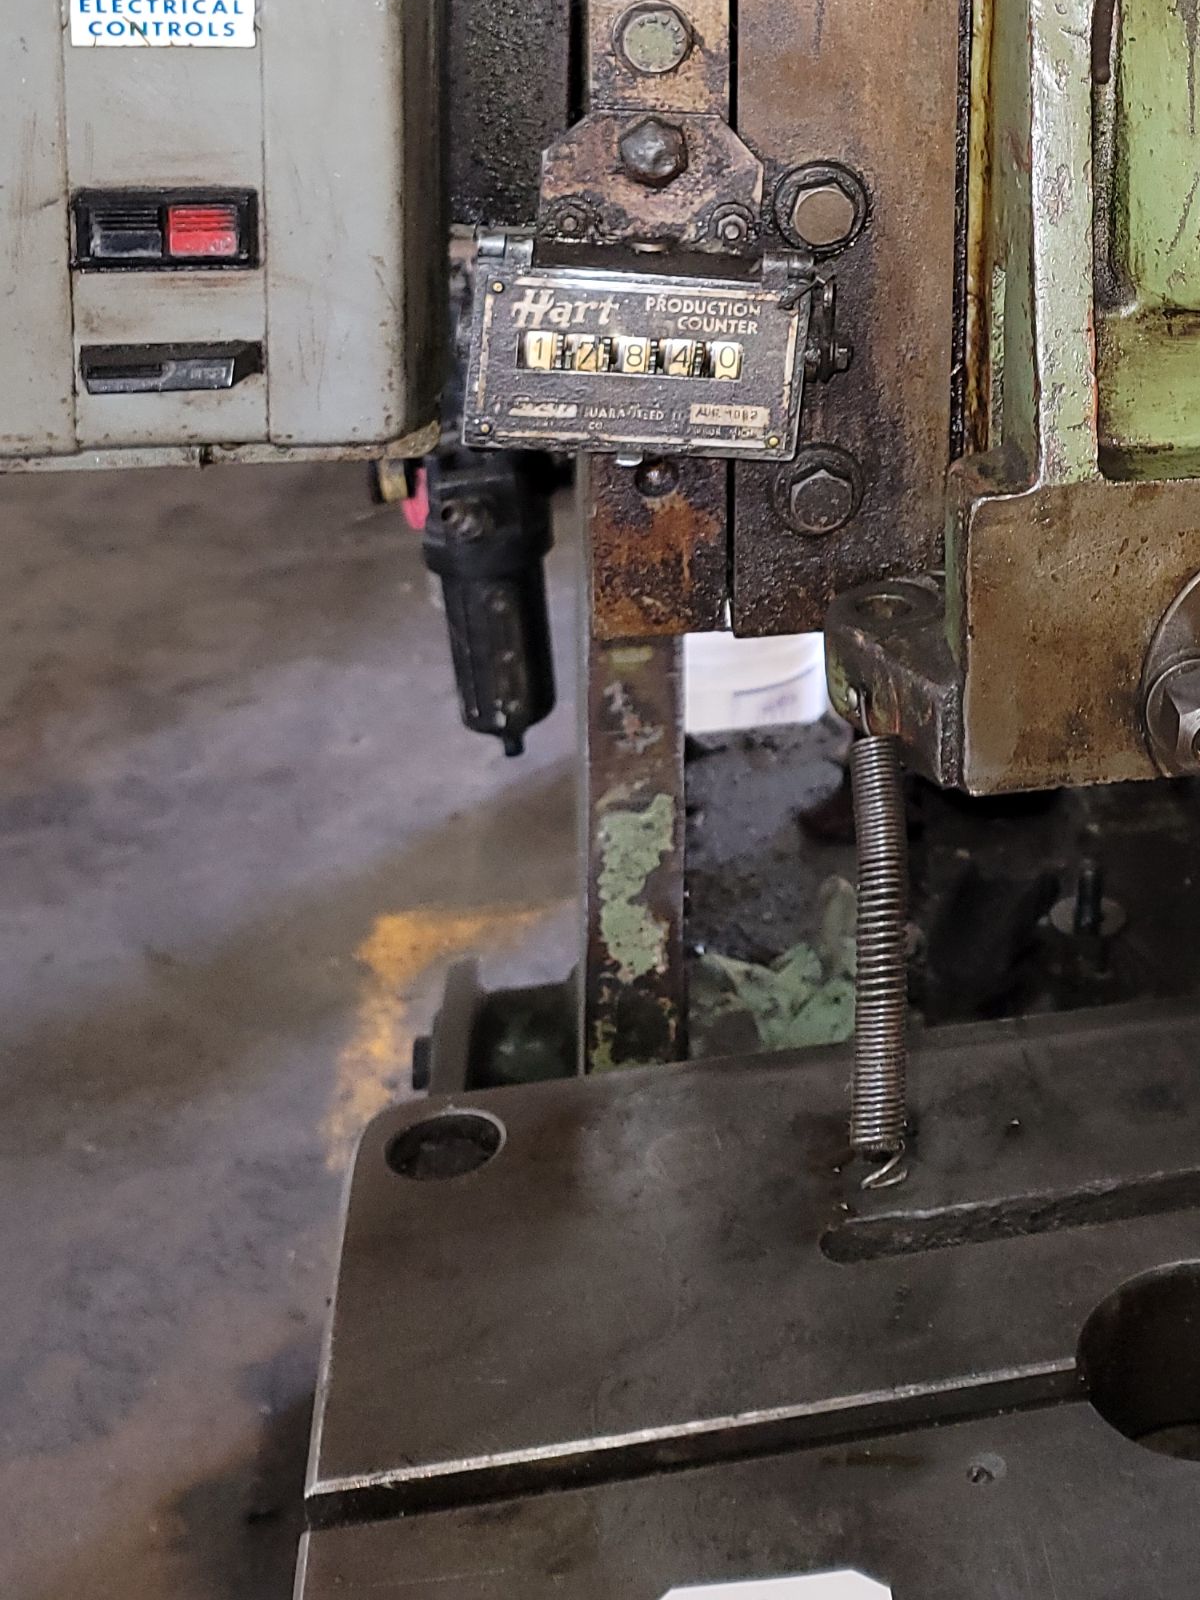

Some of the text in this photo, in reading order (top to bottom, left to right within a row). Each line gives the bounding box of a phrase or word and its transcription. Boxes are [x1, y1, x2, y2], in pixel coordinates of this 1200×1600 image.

[88, 20, 235, 38] CONTROLS
[510, 287, 761, 330] Hart PRODUCTION
[677, 315, 759, 336] COUNTER
